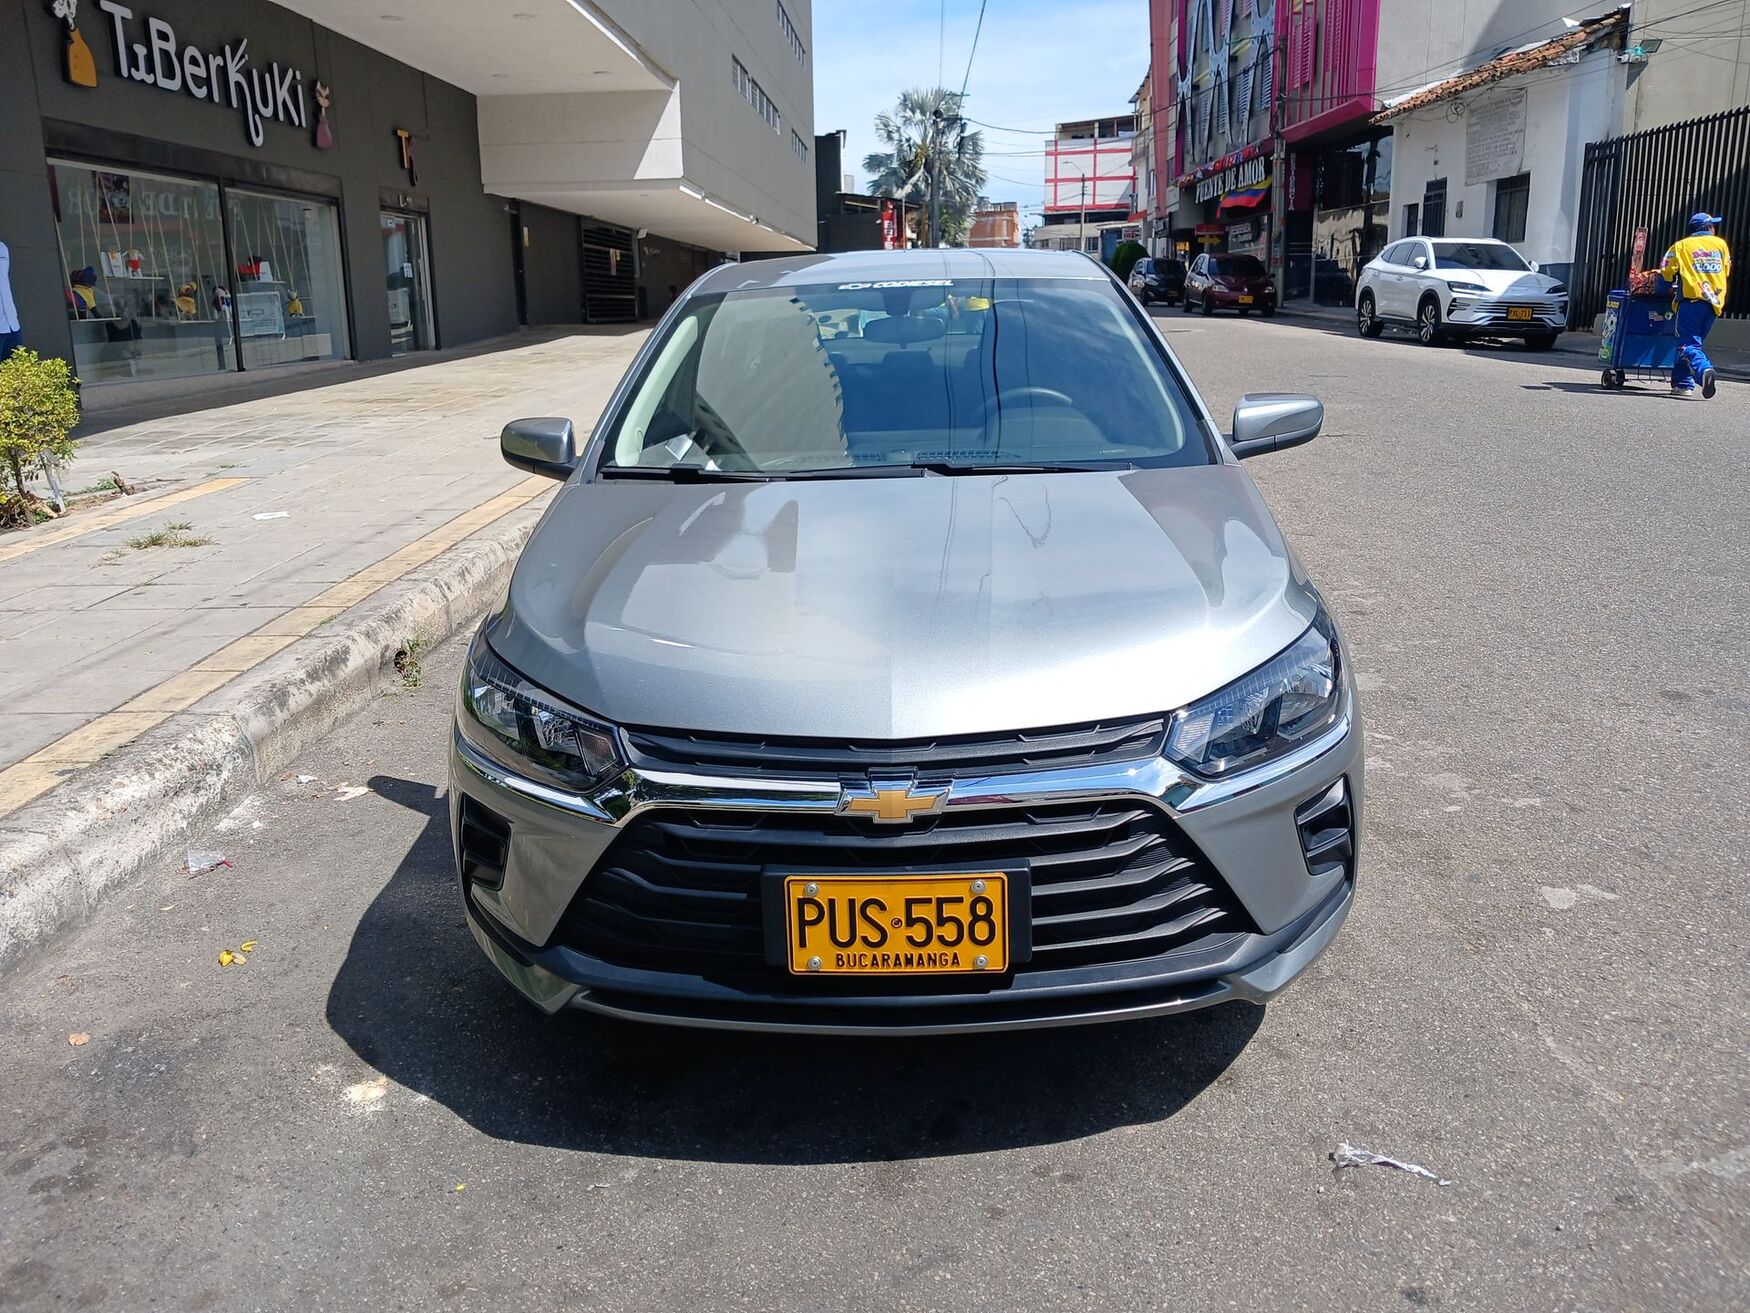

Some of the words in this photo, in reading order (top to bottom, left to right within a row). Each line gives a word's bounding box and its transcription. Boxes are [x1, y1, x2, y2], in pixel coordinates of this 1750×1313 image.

[1225, 166, 1237, 193] DE
[1237, 156, 1265, 188] AMOR
[797, 897, 889, 948] PUS
[904, 896, 996, 948] 558
[835, 951, 961, 968] BUCARAMANGA
